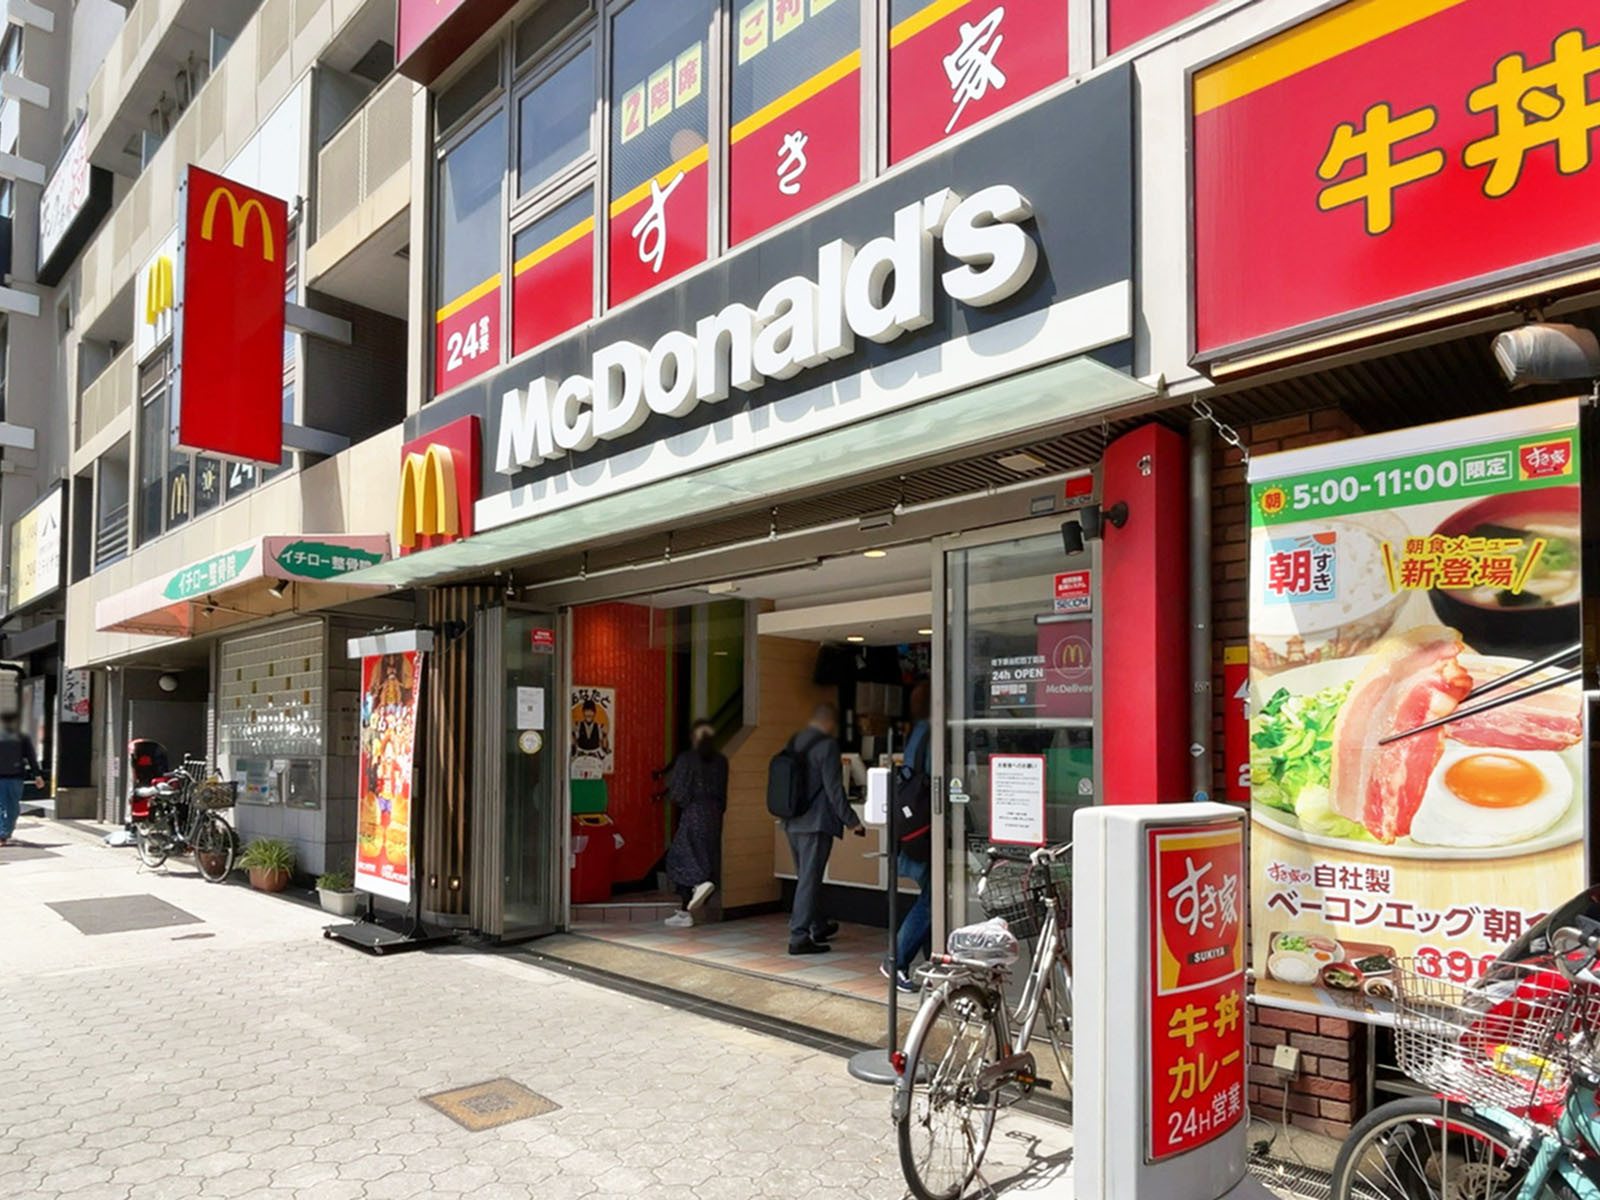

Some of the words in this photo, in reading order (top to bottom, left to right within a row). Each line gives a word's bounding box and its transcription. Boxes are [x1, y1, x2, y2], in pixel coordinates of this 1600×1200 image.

[1316, 27, 1600, 236] 牛丼
[495, 183, 1039, 475] McDonald's
[1293, 460, 1458, 510] 5:00-11:00
[1464, 458, 1508, 480] 限定
[1405, 537, 1521, 555] 朝食メニュー
[178, 554, 237, 595] イチロー整骨院
[1400, 556, 1514, 588] 新登場
[991, 670, 1011, 681] 24h
[1014, 668, 1044, 680] OPEN
[1046, 684, 1093, 694] McDeliver
[1167, 856, 1239, 938] すき家
[1193, 946, 1226, 963] SUKIYA
[1167, 989, 1240, 1048] 牛丼
[1167, 1049, 1240, 1104] カレー
